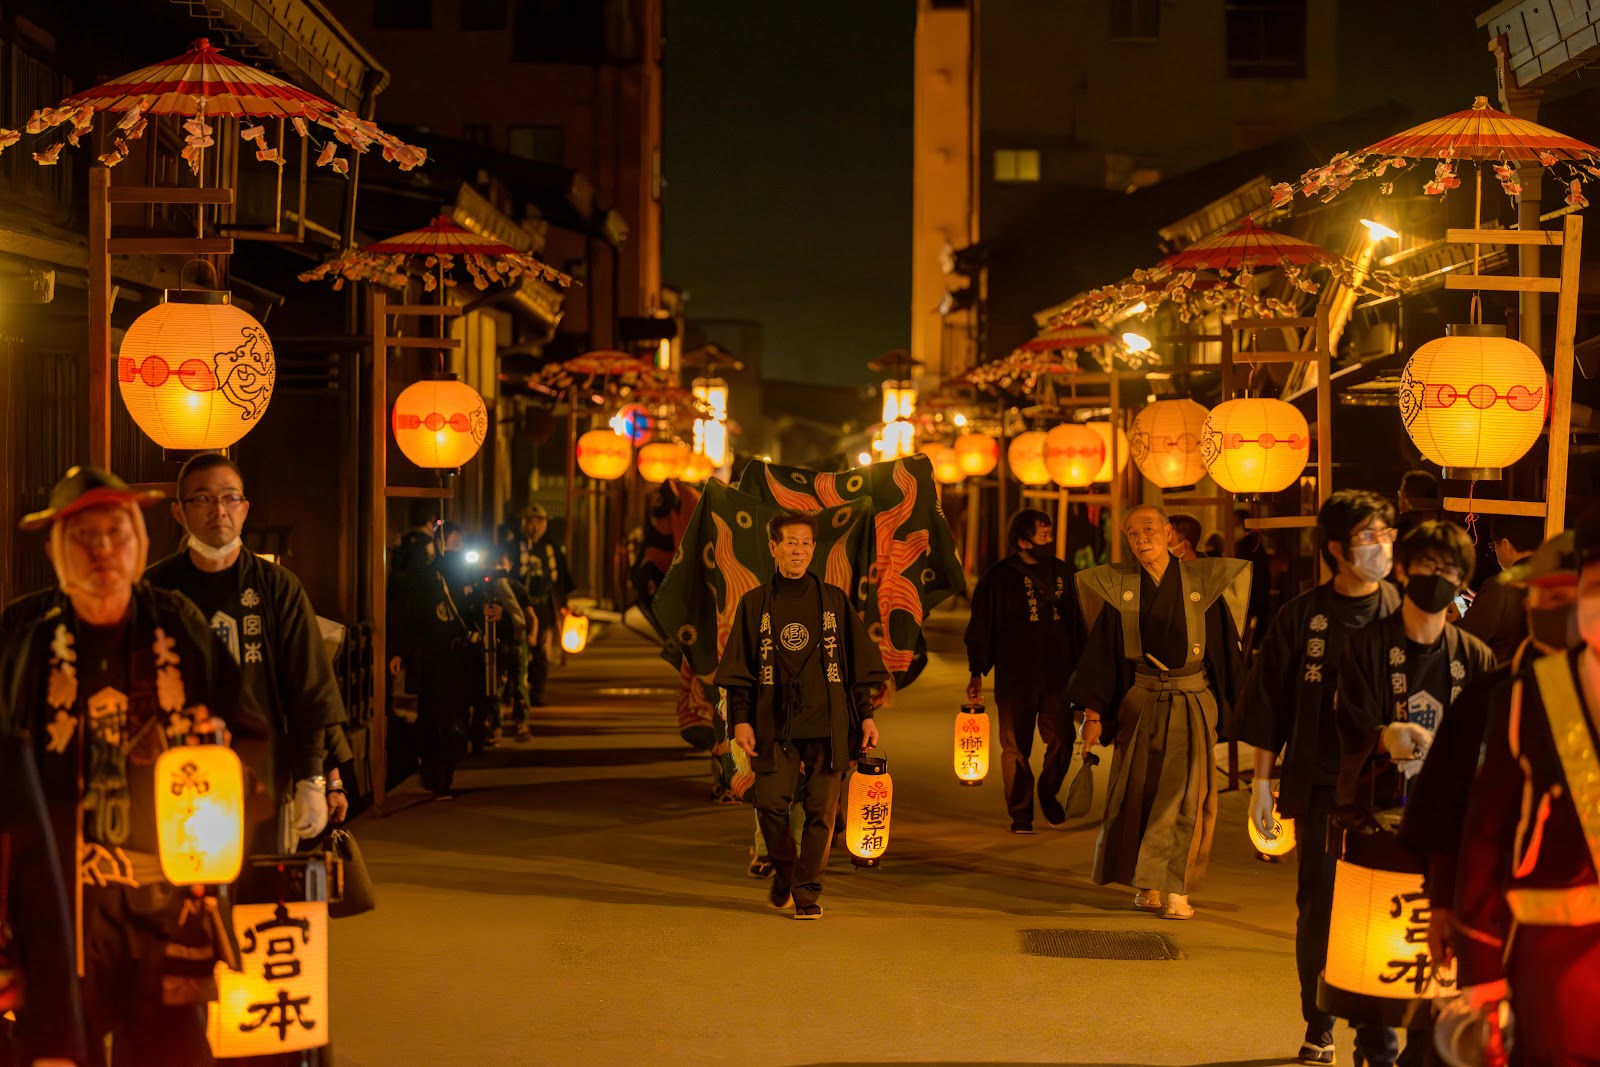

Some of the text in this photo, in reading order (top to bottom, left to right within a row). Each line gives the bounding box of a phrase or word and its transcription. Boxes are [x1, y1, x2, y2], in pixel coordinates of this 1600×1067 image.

[243, 614, 263, 663] 宮本
[822, 610, 841, 683] 獅子組
[860, 802, 888, 852] 獅子組
[240, 903, 316, 1041] 宮本
